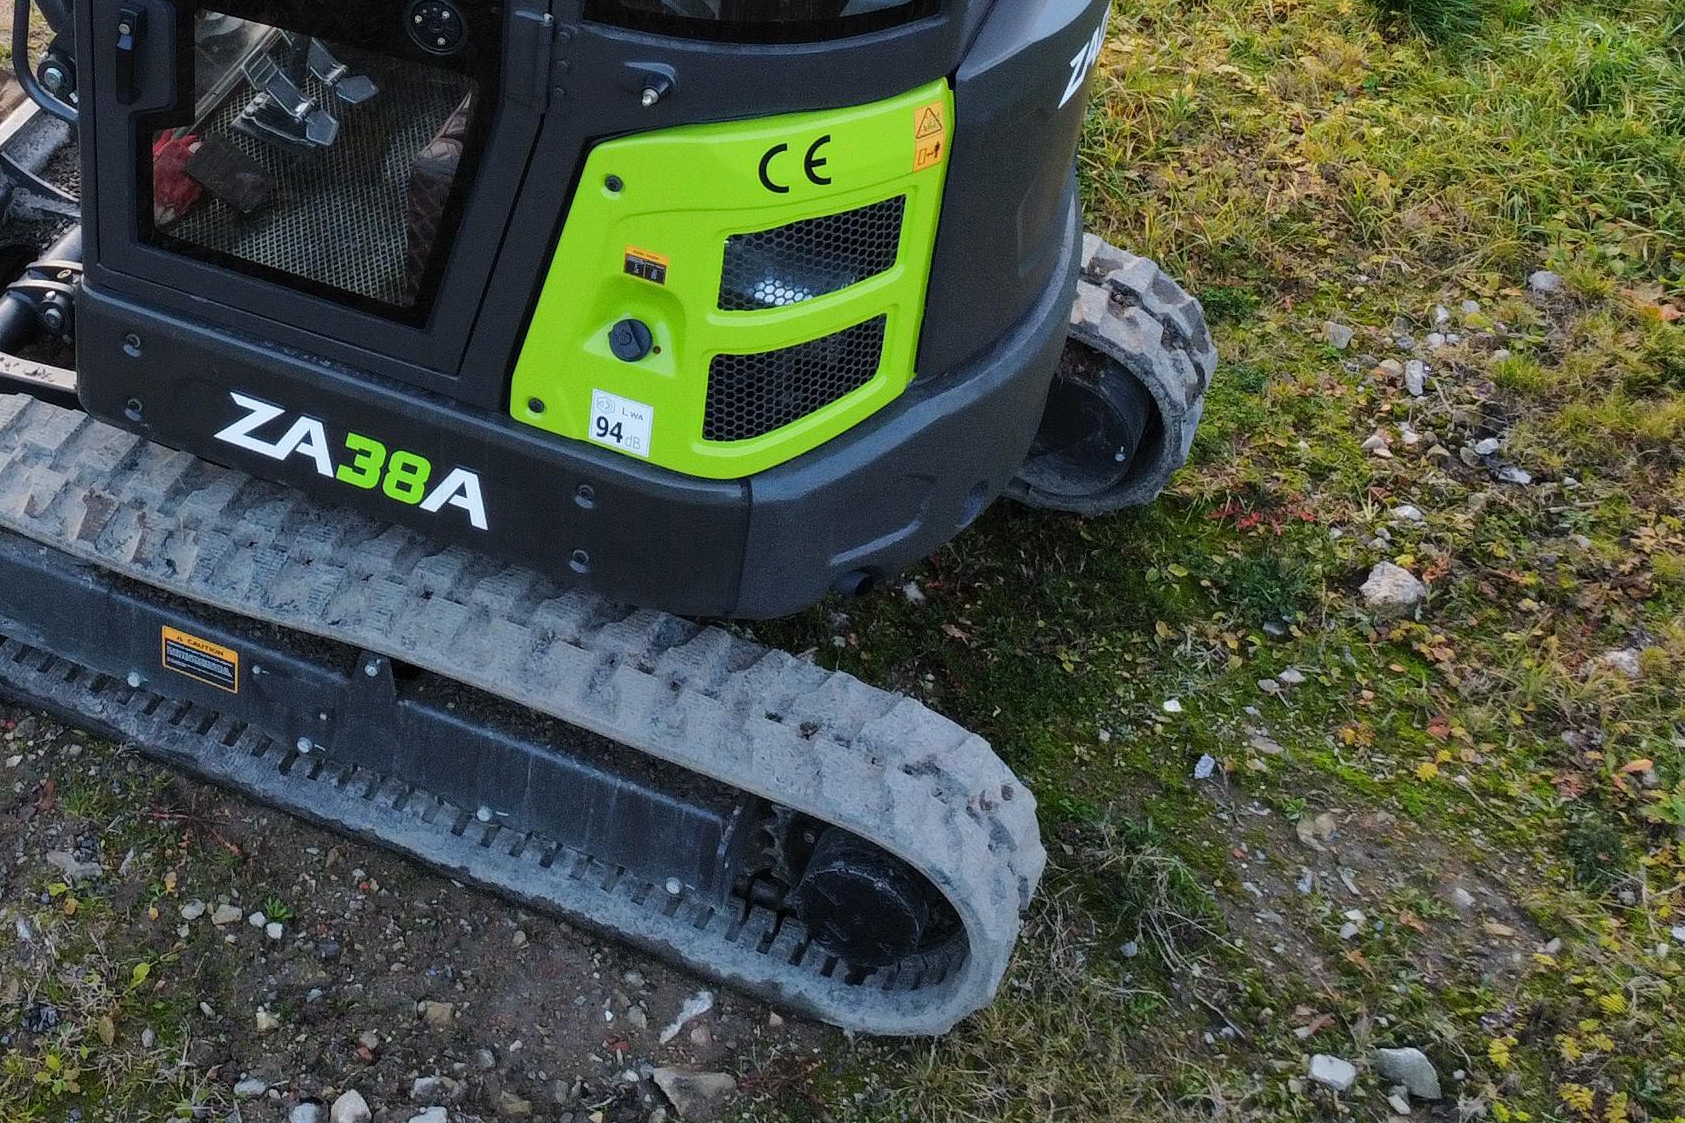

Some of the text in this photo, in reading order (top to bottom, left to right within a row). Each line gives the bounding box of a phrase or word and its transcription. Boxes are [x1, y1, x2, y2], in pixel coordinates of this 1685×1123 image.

[758, 134, 832, 194] CE
[596, 415, 623, 444] 94
[214, 391, 489, 531] ZA38A
